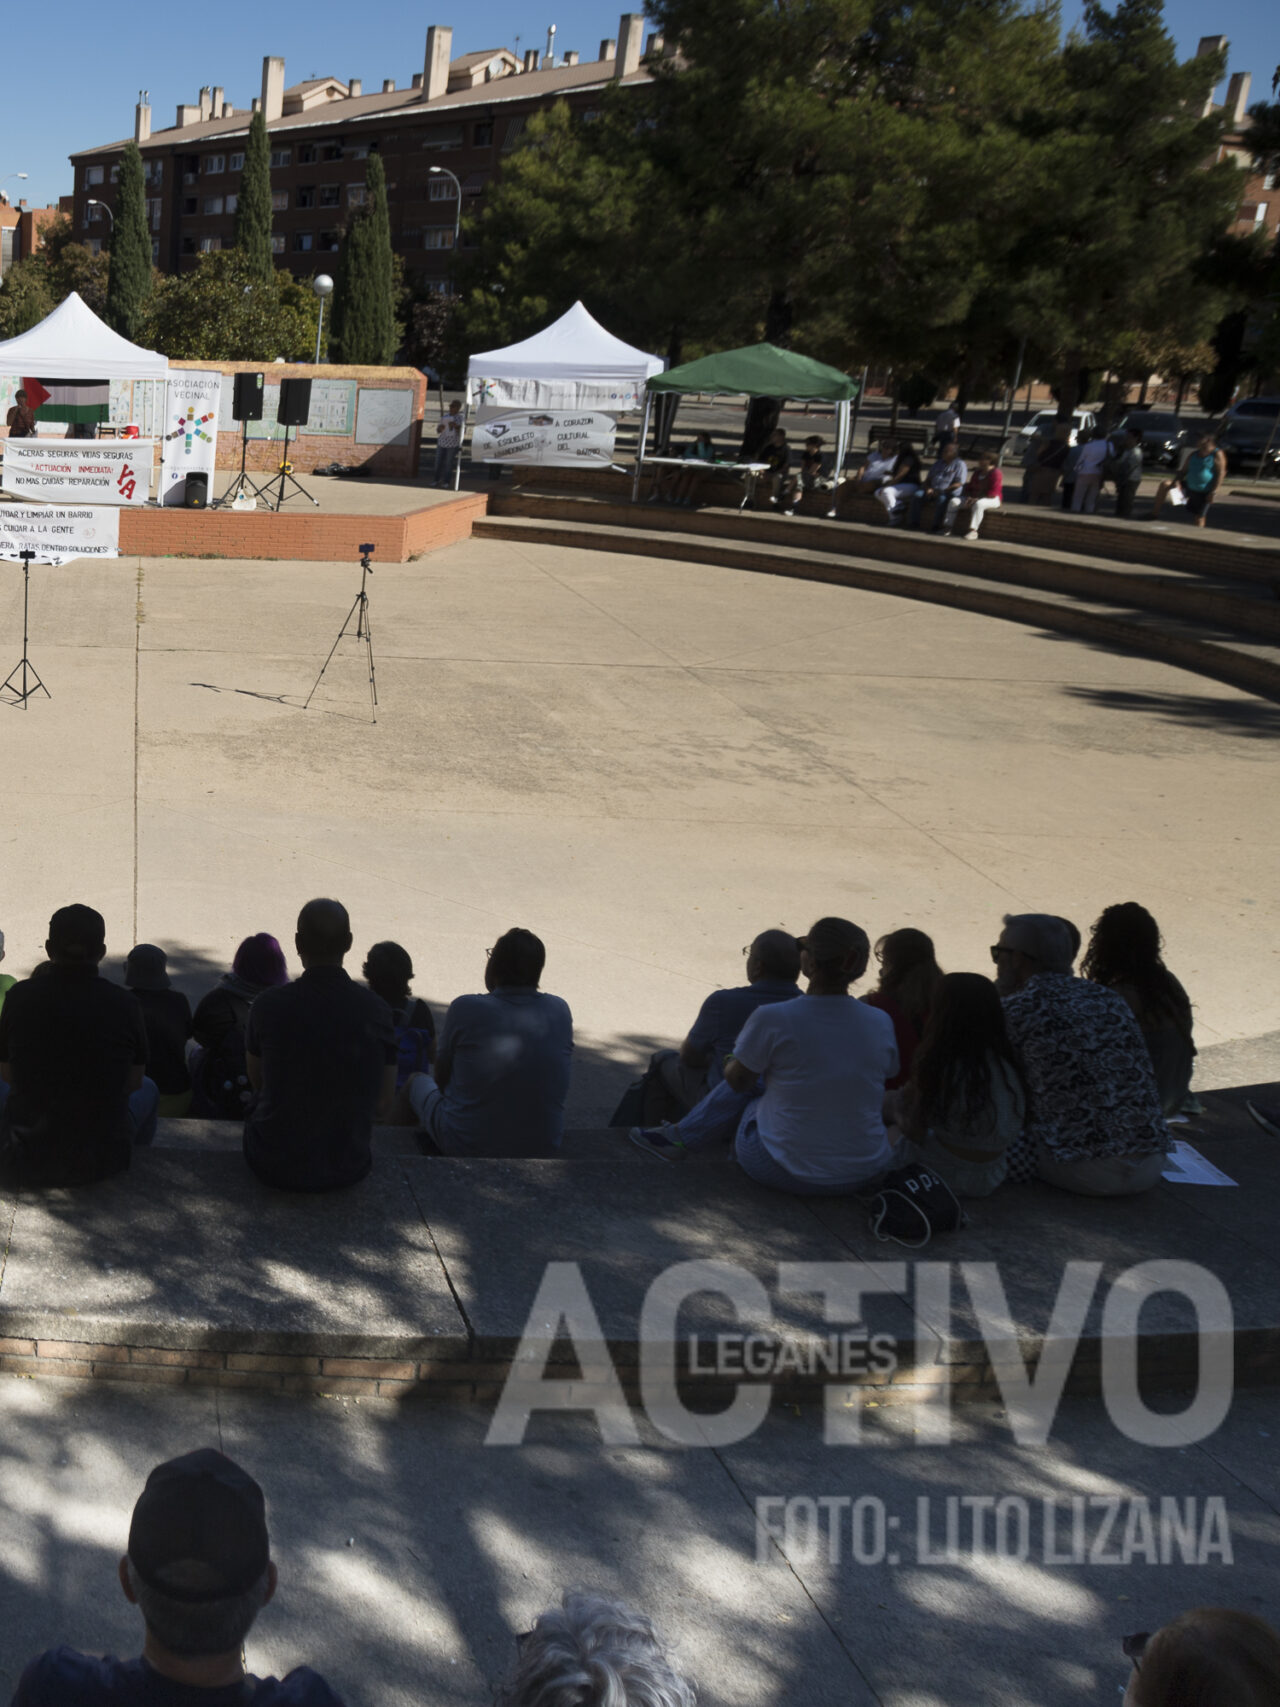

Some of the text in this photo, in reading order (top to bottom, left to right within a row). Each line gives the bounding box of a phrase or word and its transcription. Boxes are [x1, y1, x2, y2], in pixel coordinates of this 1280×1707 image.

[168, 379, 220, 389] ASOCIACIÓN
[175, 391, 209, 400] VECINAL
[103, 452, 133, 460] SEGURAS
[117, 464, 136, 500] YA
[27, 511, 53, 519] LIMPIAR
[68, 511, 93, 519] BARRIO
[4, 525, 28, 533] CUIDAR
[38, 525, 48, 533] LA
[51, 526, 75, 534] GENTE
[41, 544, 68, 552] DENTRO
[69, 546, 108, 554] SOLUCIONES
